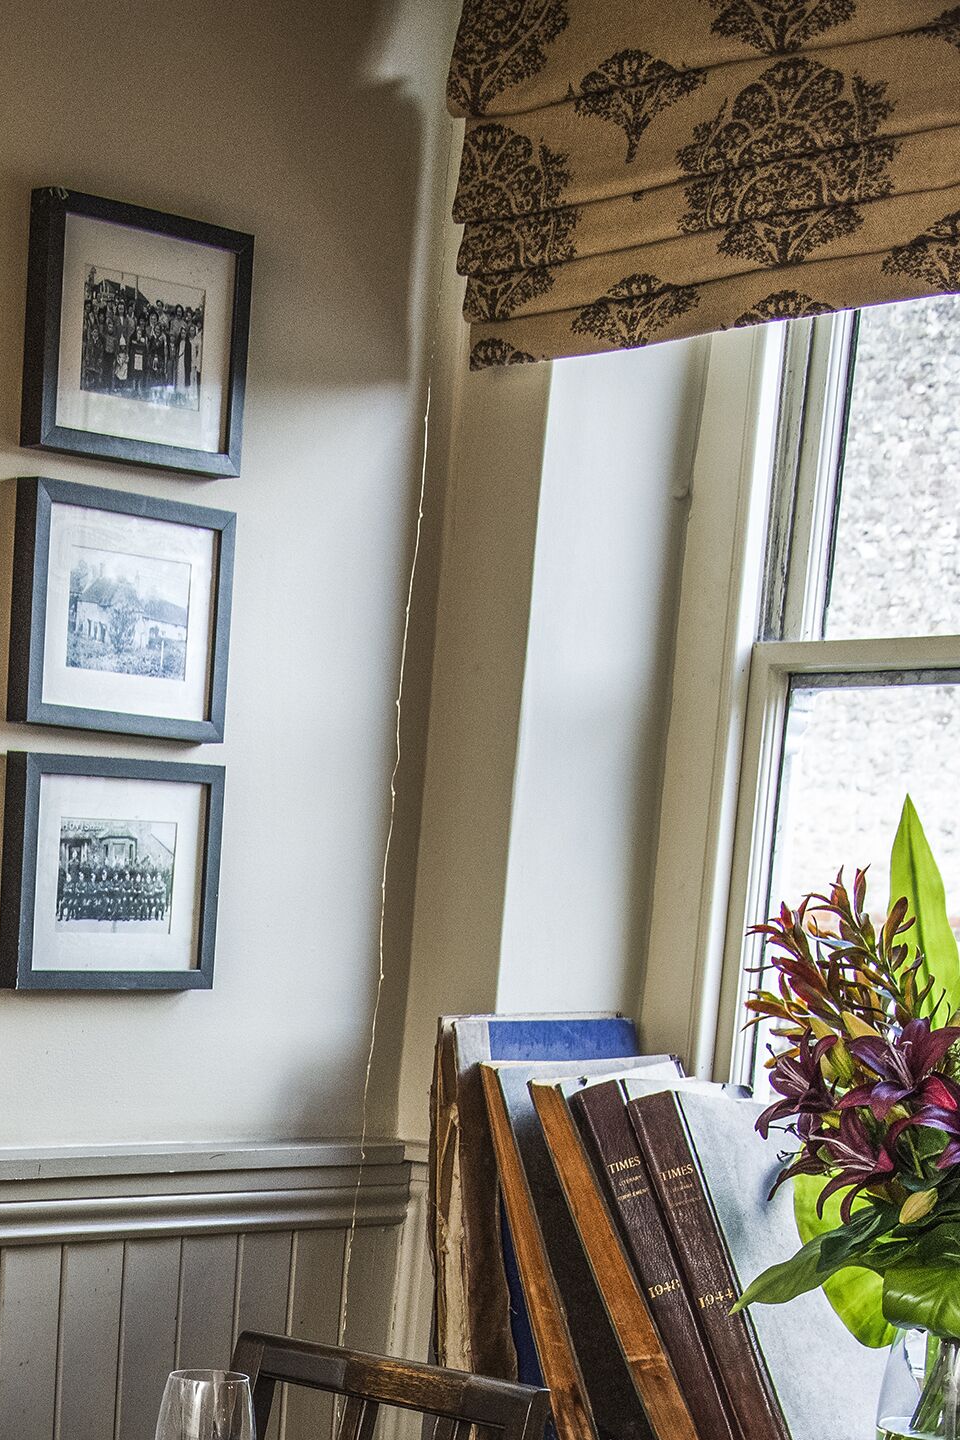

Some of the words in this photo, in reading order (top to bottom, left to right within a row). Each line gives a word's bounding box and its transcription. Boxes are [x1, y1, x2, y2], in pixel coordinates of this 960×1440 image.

[607, 1156, 640, 1174] TIMES
[660, 1163, 694, 1181] TIMES
[697, 1288, 734, 1309] 1944
